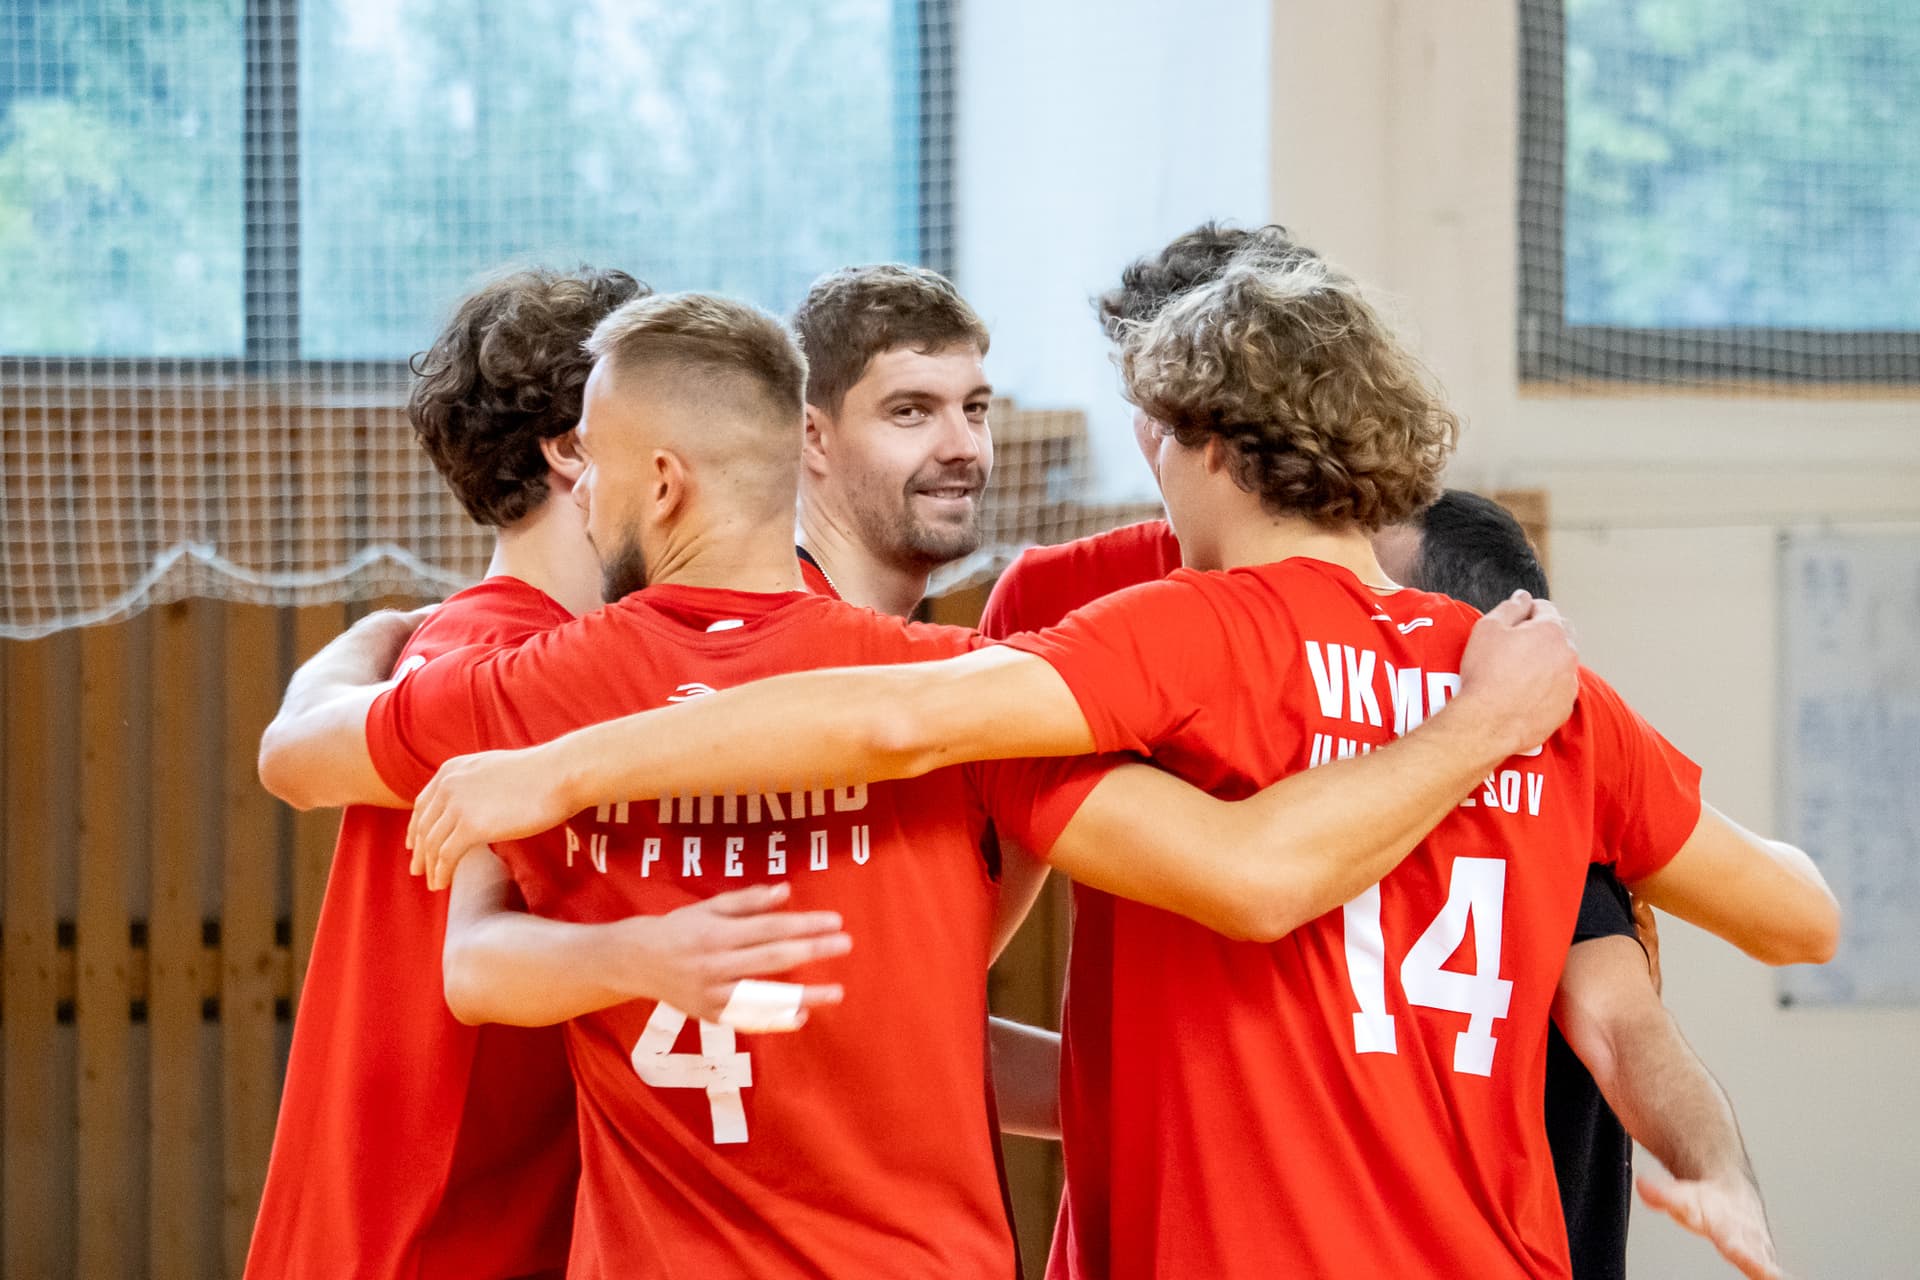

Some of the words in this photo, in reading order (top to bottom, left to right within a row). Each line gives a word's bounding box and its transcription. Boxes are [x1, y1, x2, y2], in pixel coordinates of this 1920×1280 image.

[1304, 640, 1383, 728] VK
[1343, 856, 1514, 1078] 14
[631, 1000, 753, 1145] 4
